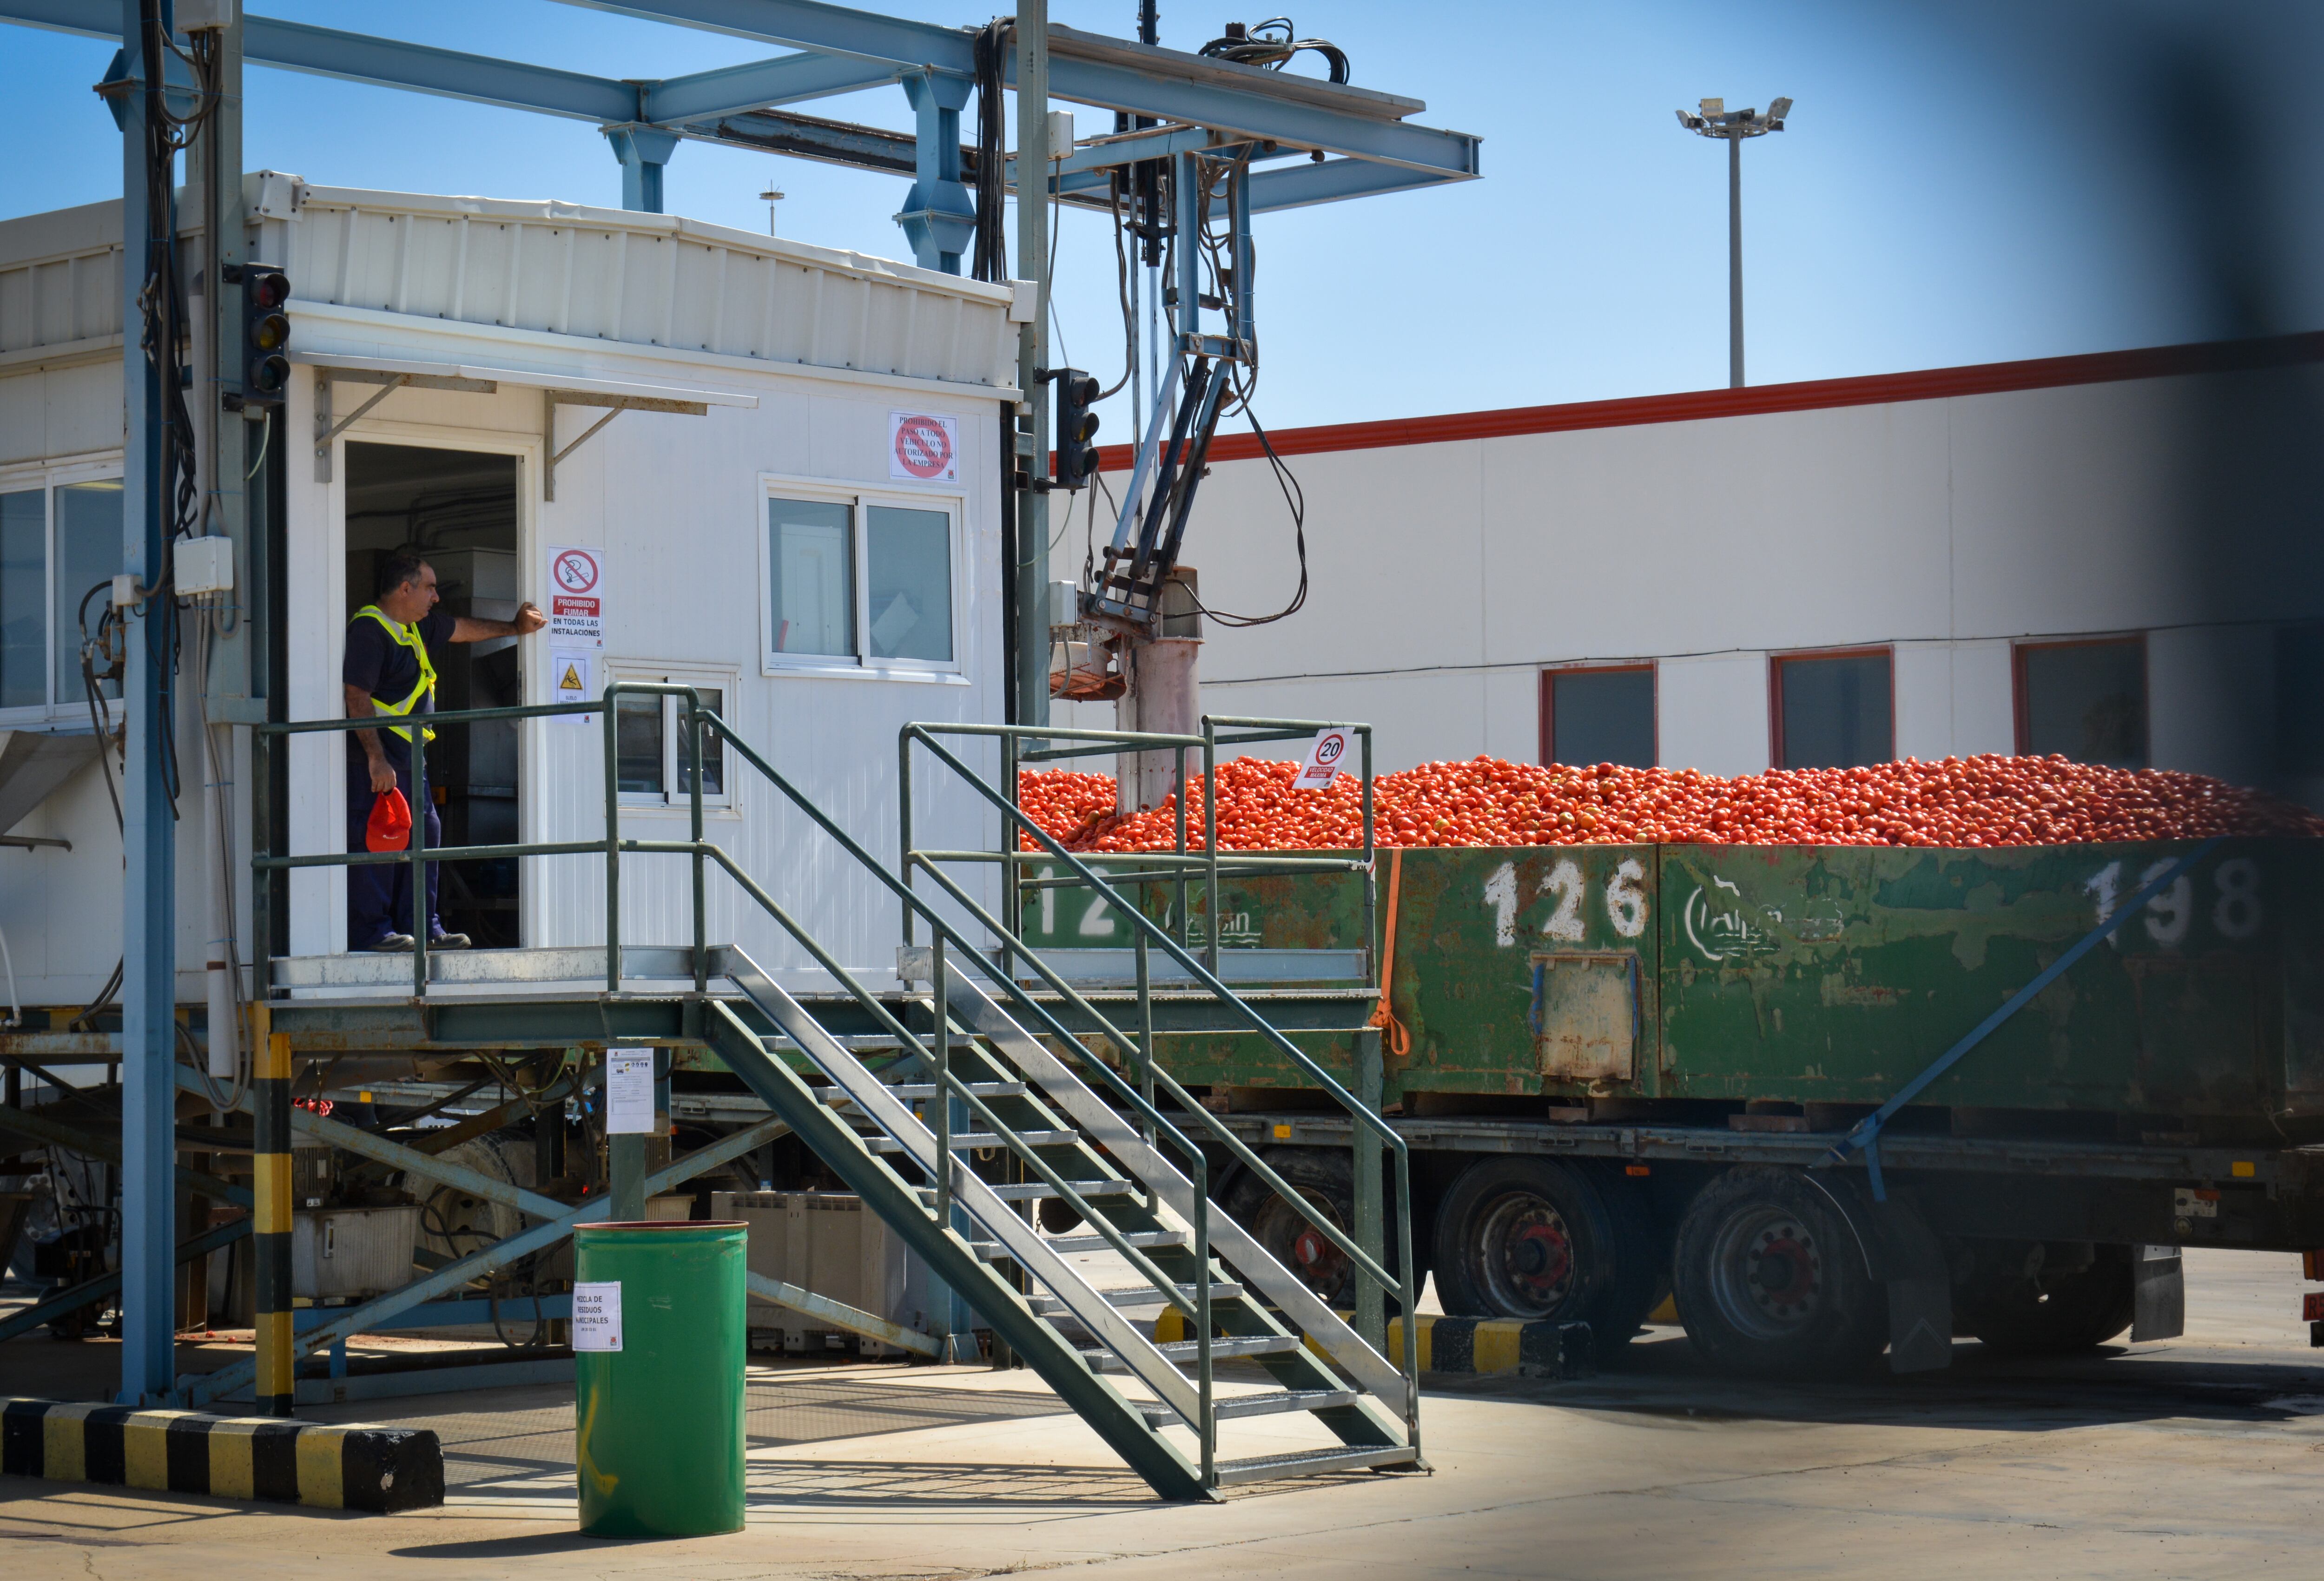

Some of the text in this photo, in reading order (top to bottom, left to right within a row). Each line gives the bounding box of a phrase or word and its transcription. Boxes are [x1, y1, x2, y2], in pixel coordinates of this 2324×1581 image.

[899, 416, 937, 427] PROHIBIDO
[900, 437, 935, 447] VEHICULO
[894, 448, 938, 457] AUTORIZADO
[913, 459, 944, 468] EMPRESA
[557, 598, 595, 608] PROHIBIDO
[563, 608, 589, 617] FUMAR
[551, 627, 600, 637] INSTALACIONES
[1320, 742, 1340, 757] 20
[1483, 857, 1651, 949] 126
[2084, 856, 2263, 949] 198
